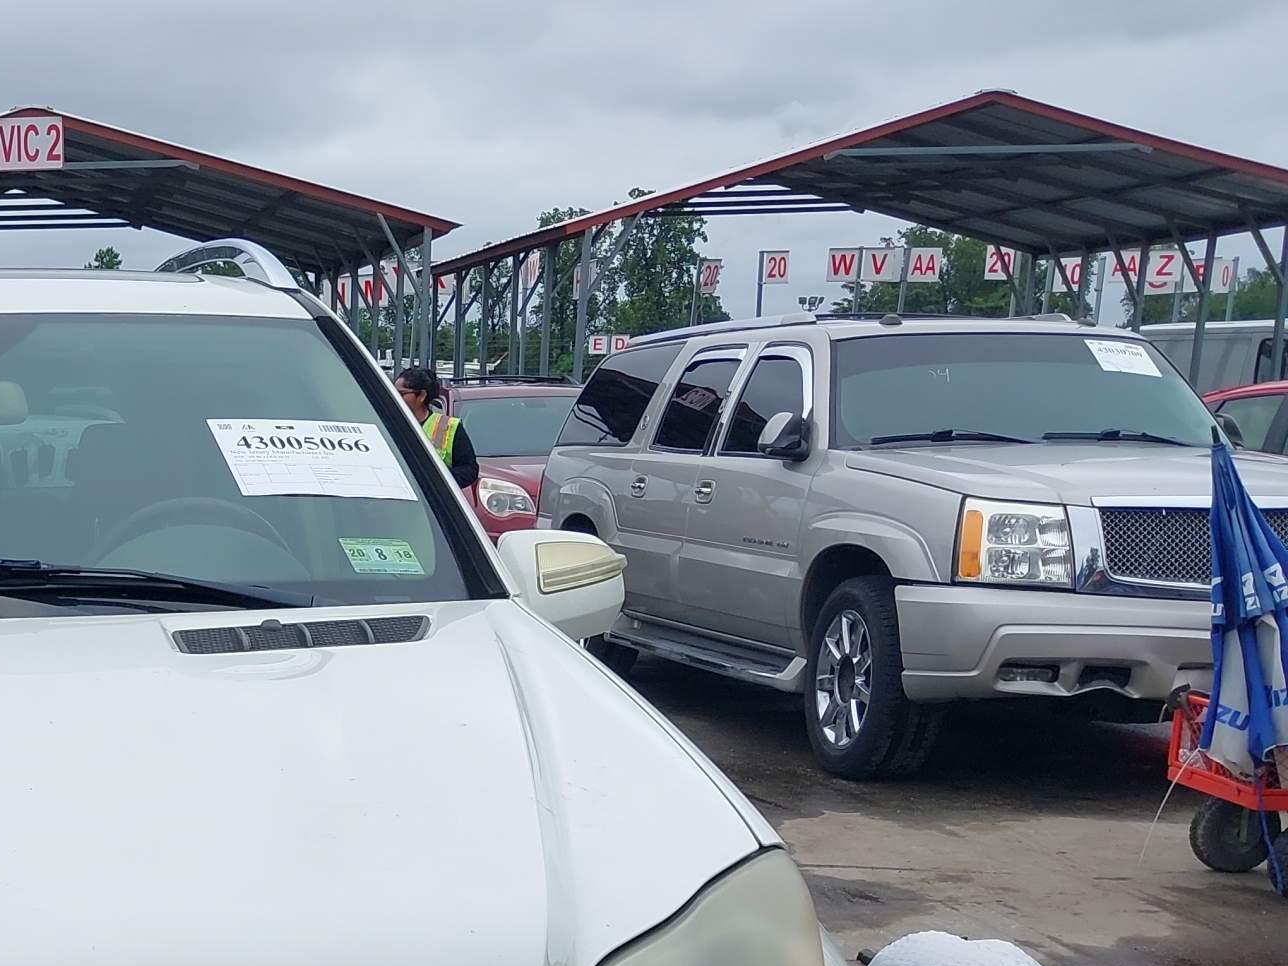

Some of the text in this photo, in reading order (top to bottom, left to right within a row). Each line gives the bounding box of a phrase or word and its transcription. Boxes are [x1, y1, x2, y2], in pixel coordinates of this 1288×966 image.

[46, 123, 61, 161] 2
[703, 264, 719, 286] 20
[767, 256, 787, 278] 20
[831, 254, 855, 276] W
[871, 253, 888, 275] V
[912, 254, 936, 276] AA
[1156, 255, 1175, 276] Z
[593, 338, 602, 351] E
[615, 337, 625, 351] D
[236, 435, 370, 452] 43005066
[348, 547, 413, 561] 20 8 18
